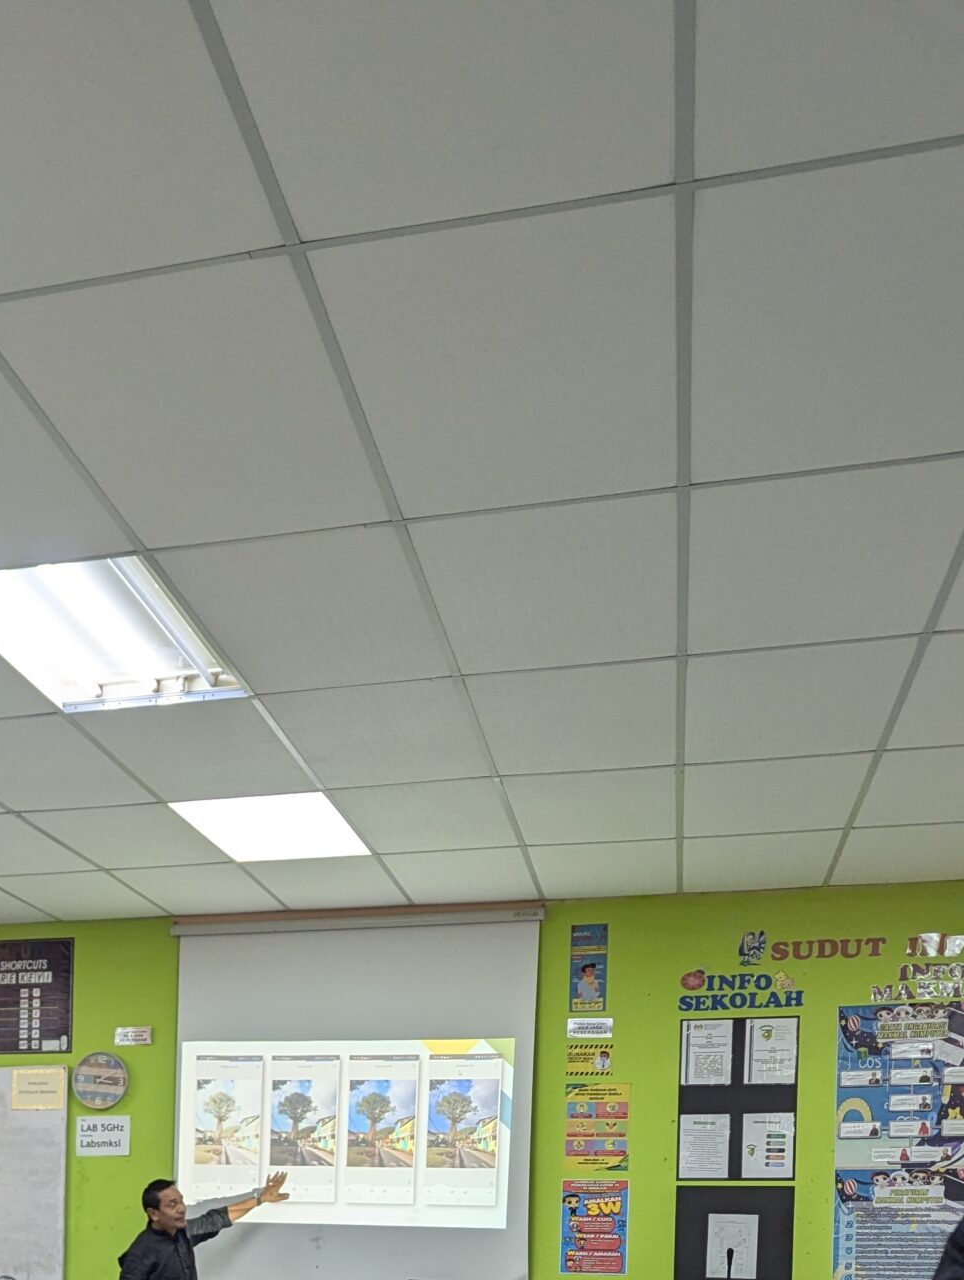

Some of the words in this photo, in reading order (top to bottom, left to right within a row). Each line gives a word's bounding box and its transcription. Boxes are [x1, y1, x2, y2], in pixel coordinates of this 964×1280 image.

[770, 936, 887, 961] SUDUT
[0, 959, 48, 971] SHORTCUTS
[706, 973, 773, 992] INFO
[678, 989, 805, 1012] SEKOLAH
[98, 1055, 107, 1064] 12
[117, 1077, 125, 1086] 3
[95, 1096, 102, 1105] 6
[81, 1123, 98, 1132] LAB
[100, 1123, 125, 1132] 5GHz
[586, 1201, 622, 1216] 3W
